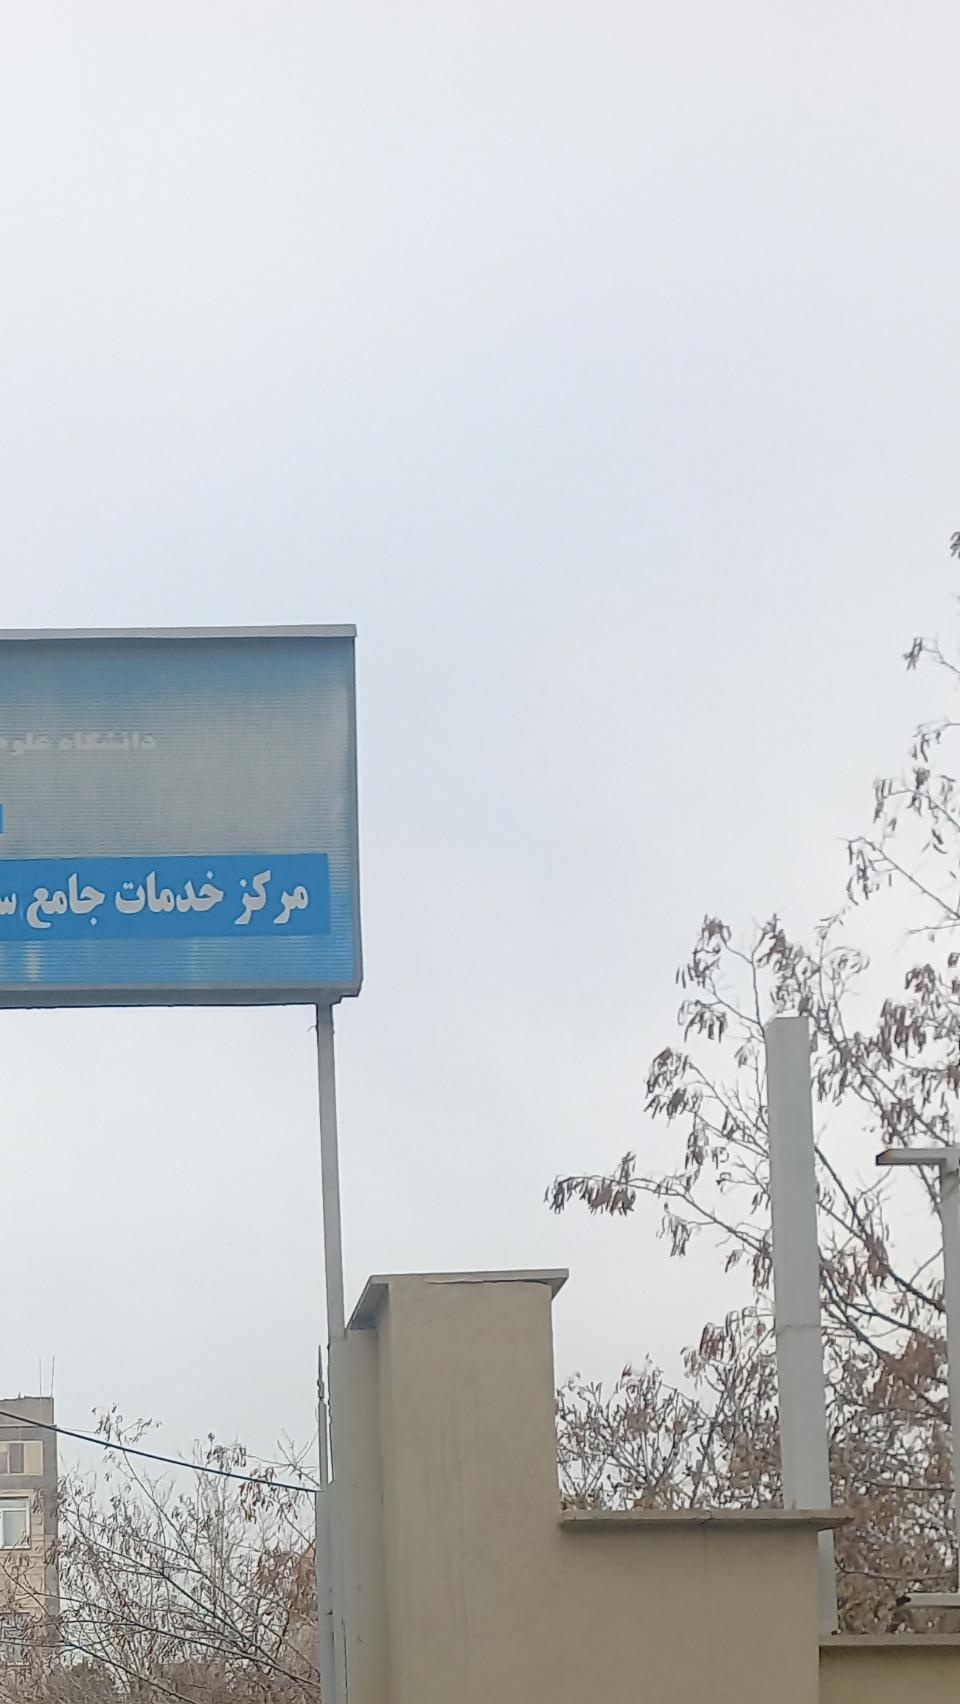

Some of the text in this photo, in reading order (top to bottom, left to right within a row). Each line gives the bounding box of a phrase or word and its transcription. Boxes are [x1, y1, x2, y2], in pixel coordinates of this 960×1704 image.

[59, 731, 157, 752] دانشگاه
[26, 872, 107, 930] جامع
[114, 870, 225, 915] خدمات
[234, 869, 310, 926] مرکز
